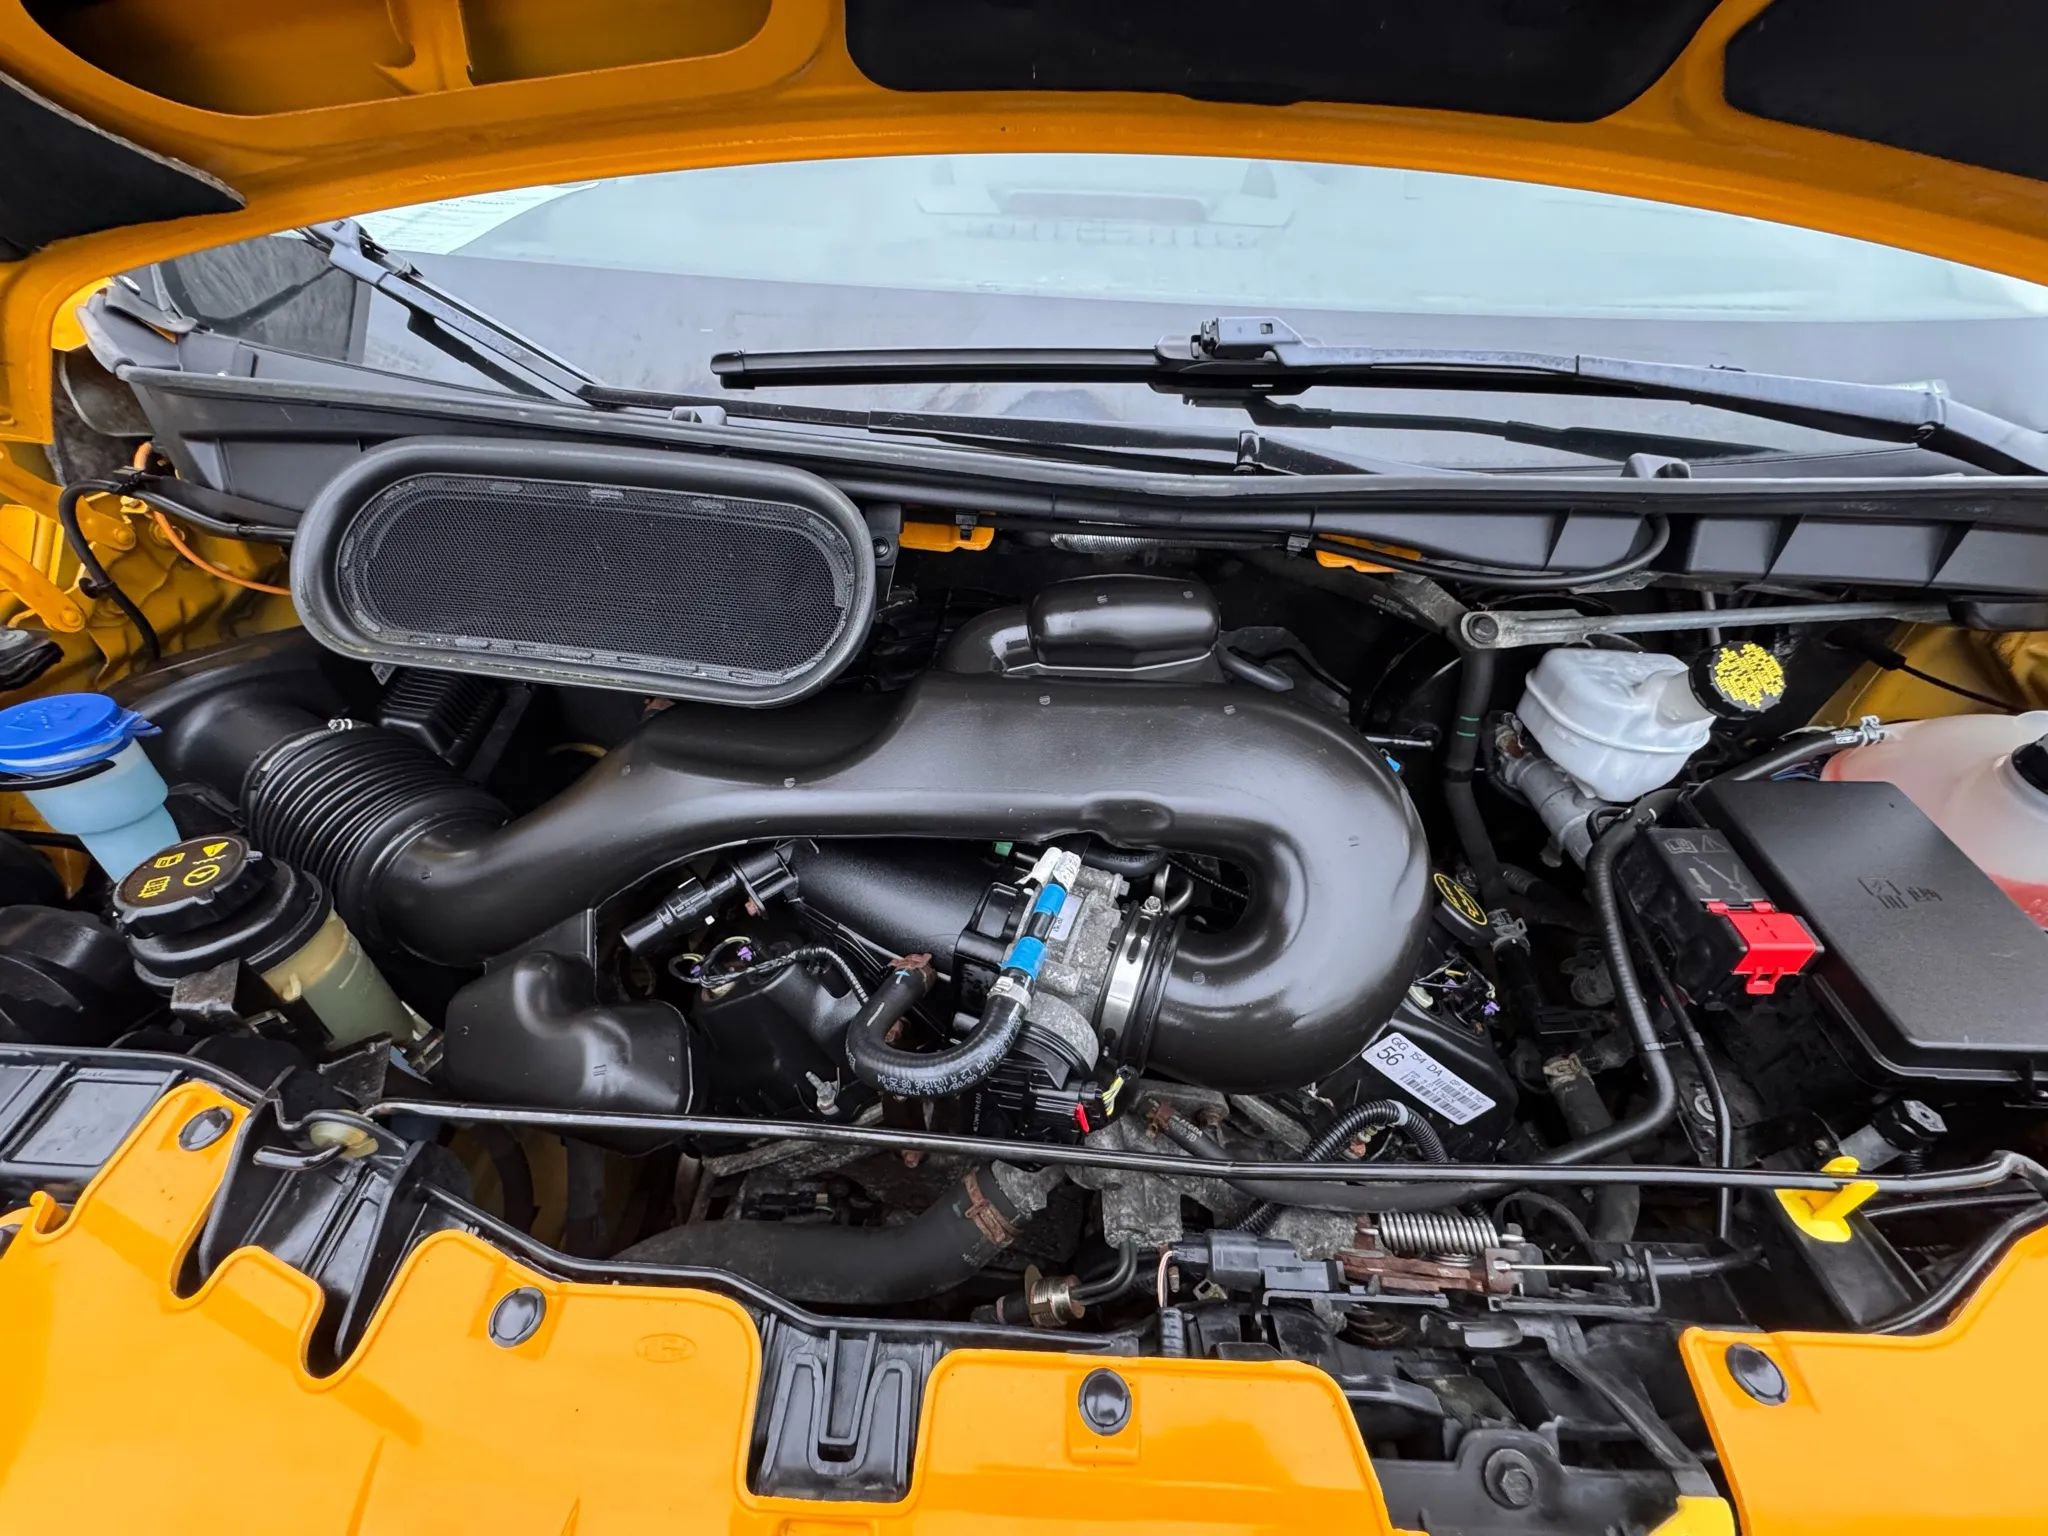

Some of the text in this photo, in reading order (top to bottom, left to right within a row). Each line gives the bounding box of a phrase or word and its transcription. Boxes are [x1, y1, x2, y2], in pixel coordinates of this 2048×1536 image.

[1376, 1046, 1405, 1066] 56
[1391, 1037, 1409, 1051] GG
[1426, 1064, 1443, 1077] DA
